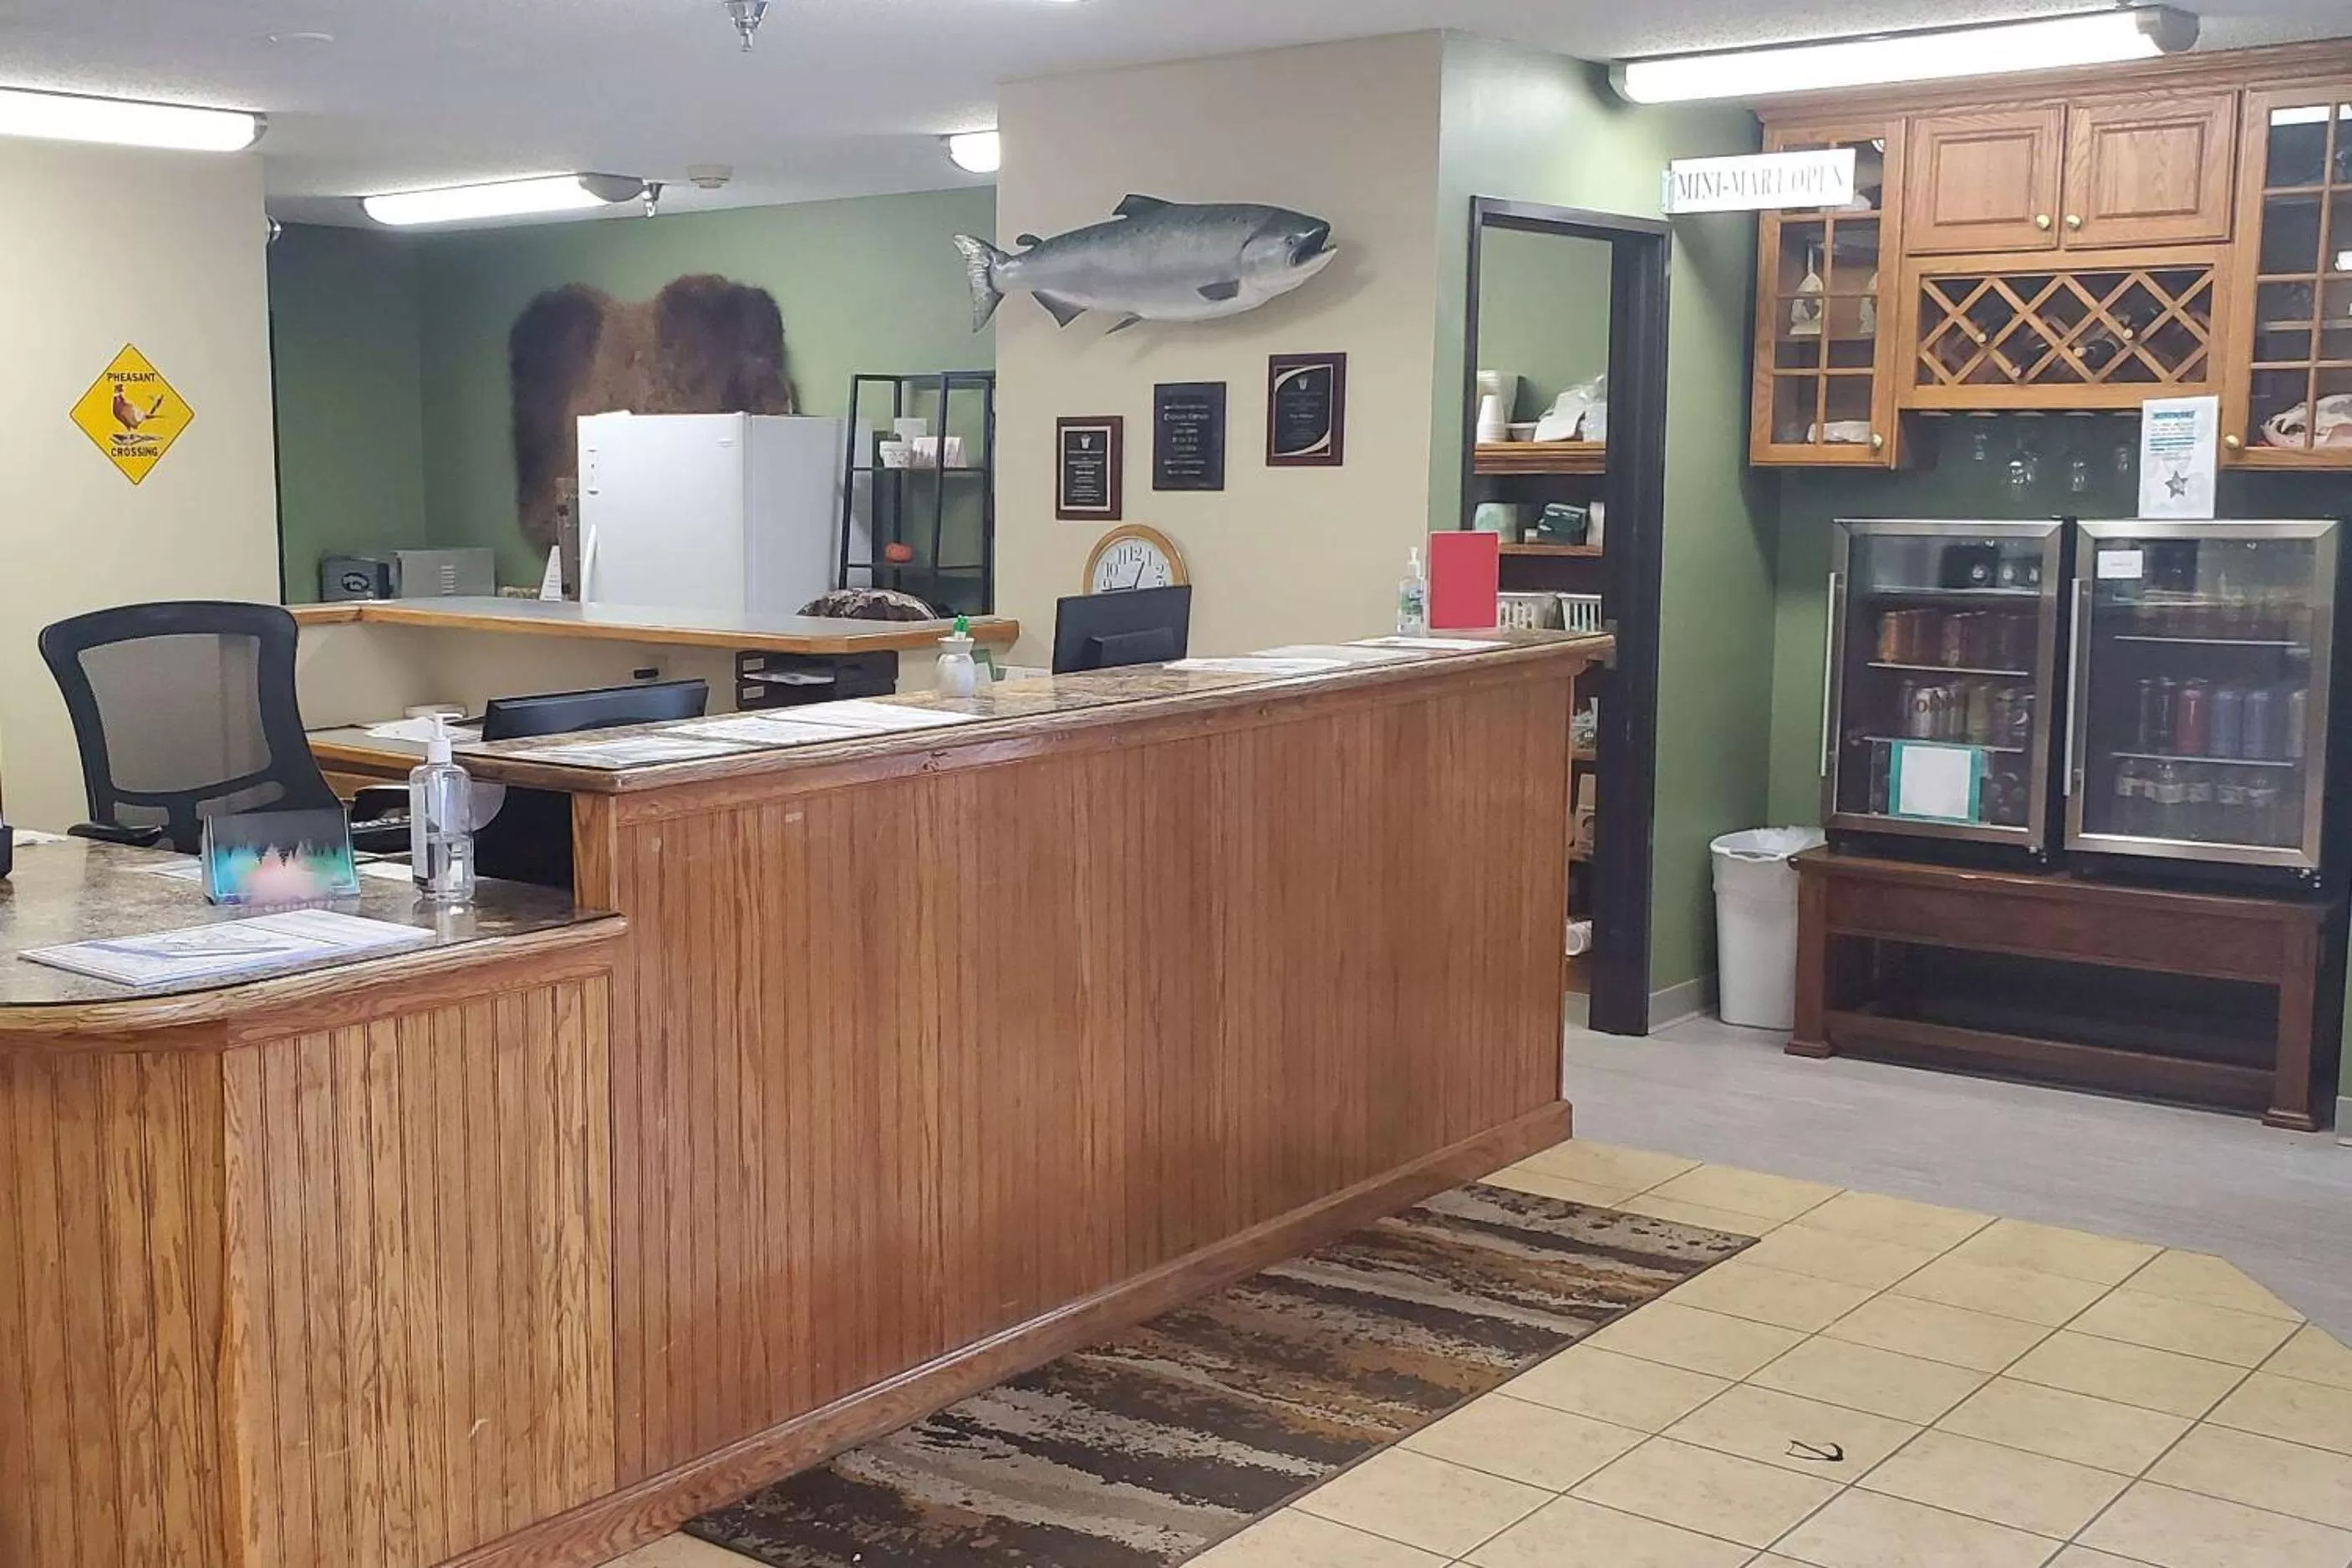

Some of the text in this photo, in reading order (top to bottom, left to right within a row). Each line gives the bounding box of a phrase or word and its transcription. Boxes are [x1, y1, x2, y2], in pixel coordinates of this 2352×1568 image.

[107, 373, 155, 383] PHEASANT
[110, 447, 158, 457] CROSSING
[1118, 547, 1128, 565] 11
[1129, 546, 1143, 562] 12
[1148, 551, 1153, 567] 1
[1106, 562, 1119, 578] 10
[1155, 564, 1165, 579] 2
